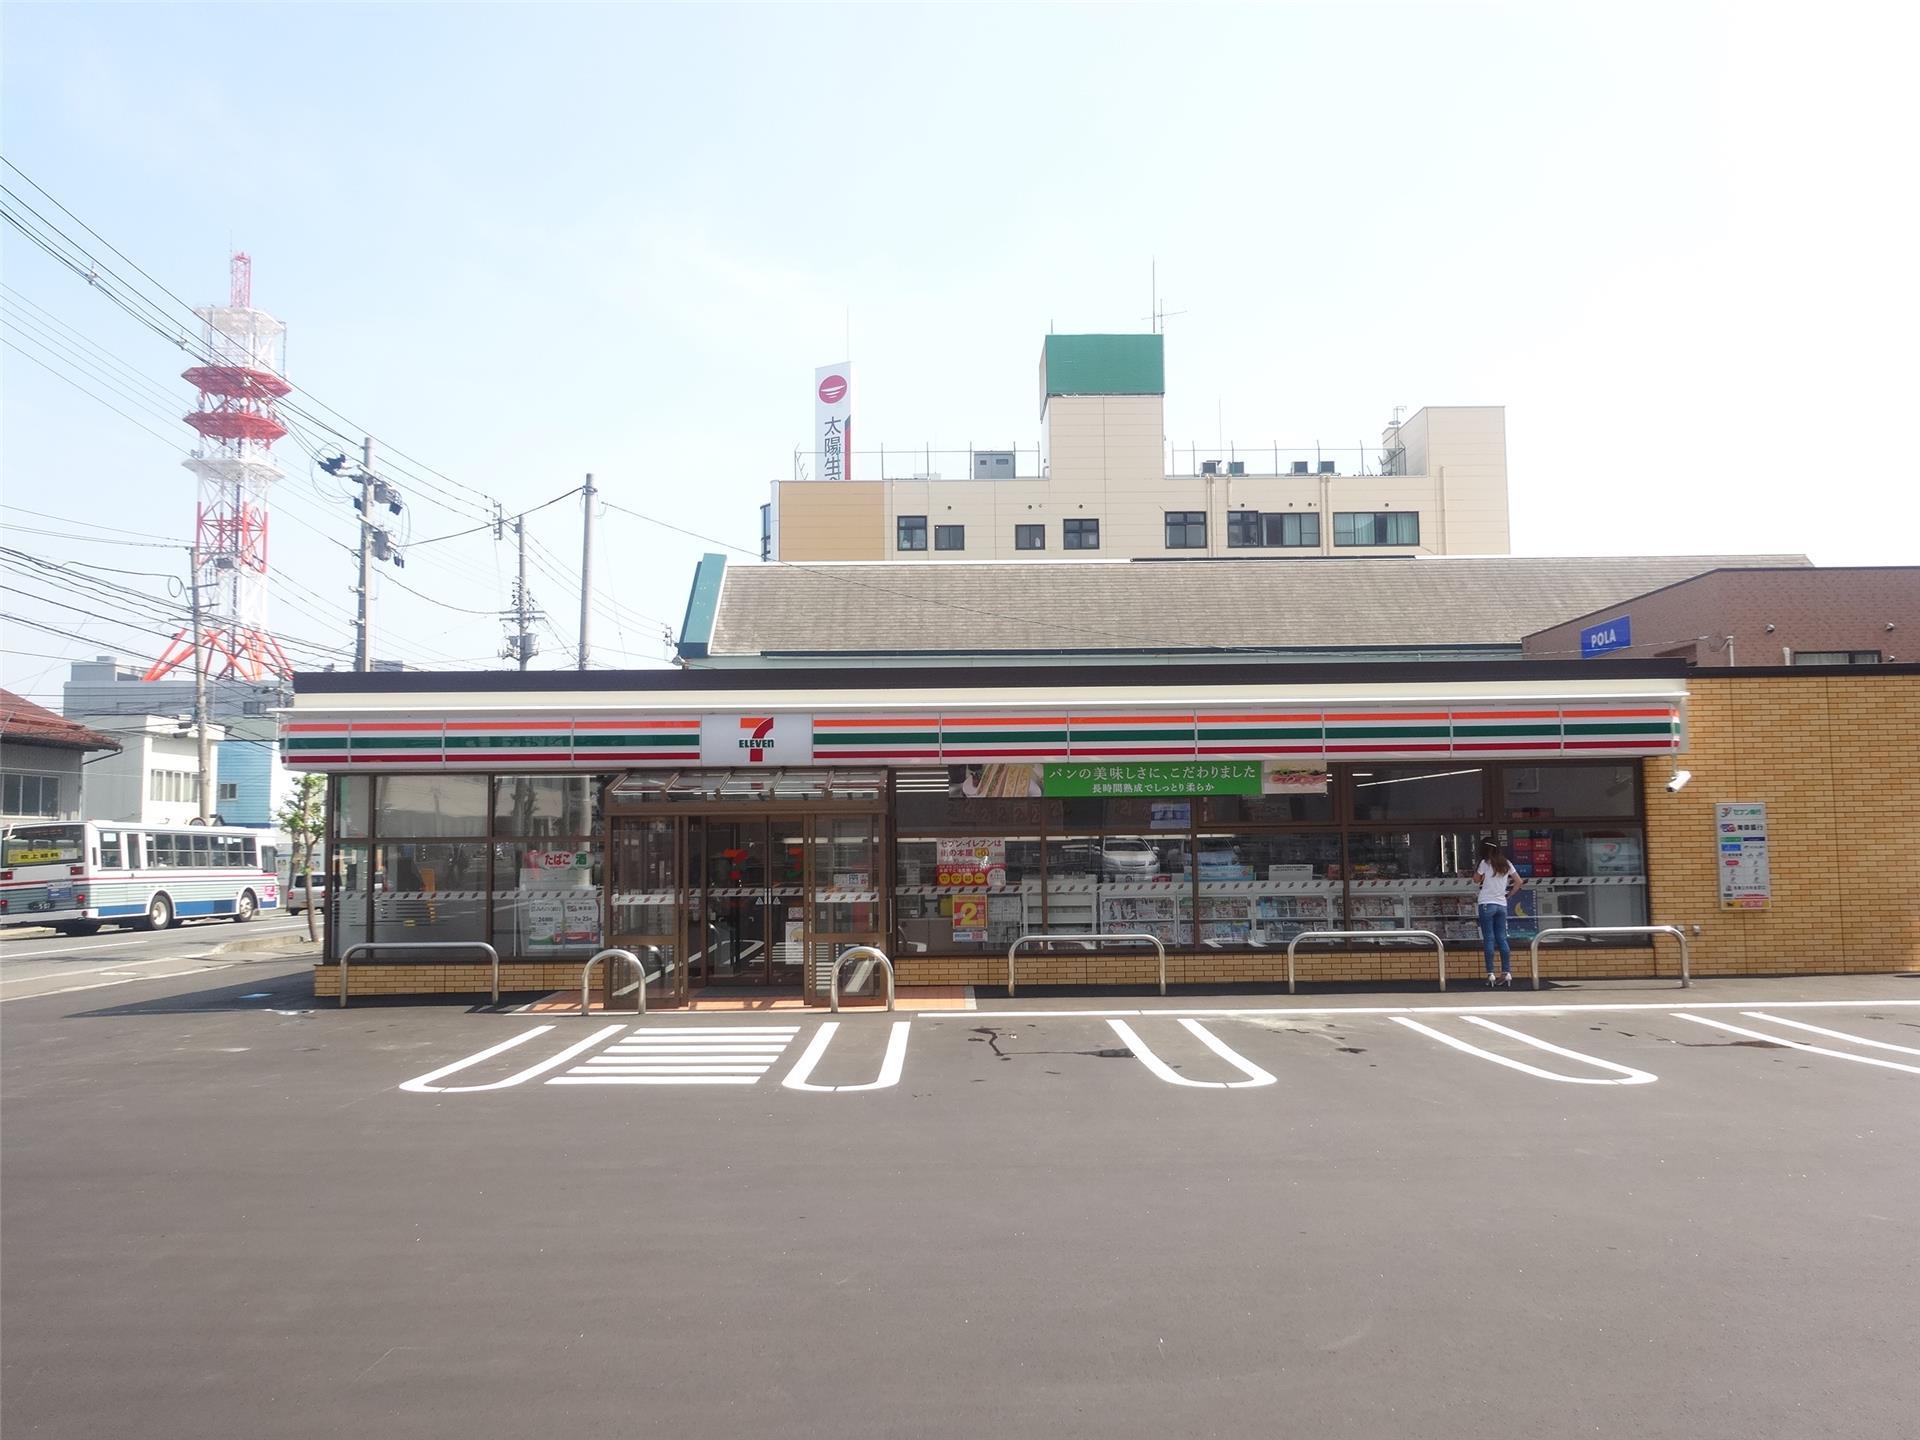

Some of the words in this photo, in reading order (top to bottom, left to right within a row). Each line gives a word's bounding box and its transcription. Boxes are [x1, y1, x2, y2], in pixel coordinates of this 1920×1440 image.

[824, 416, 842, 480] 太陽生
[1591, 628, 1617, 648] POLA
[544, 854, 571, 865] たばこ
[575, 853, 587, 865] 酒
